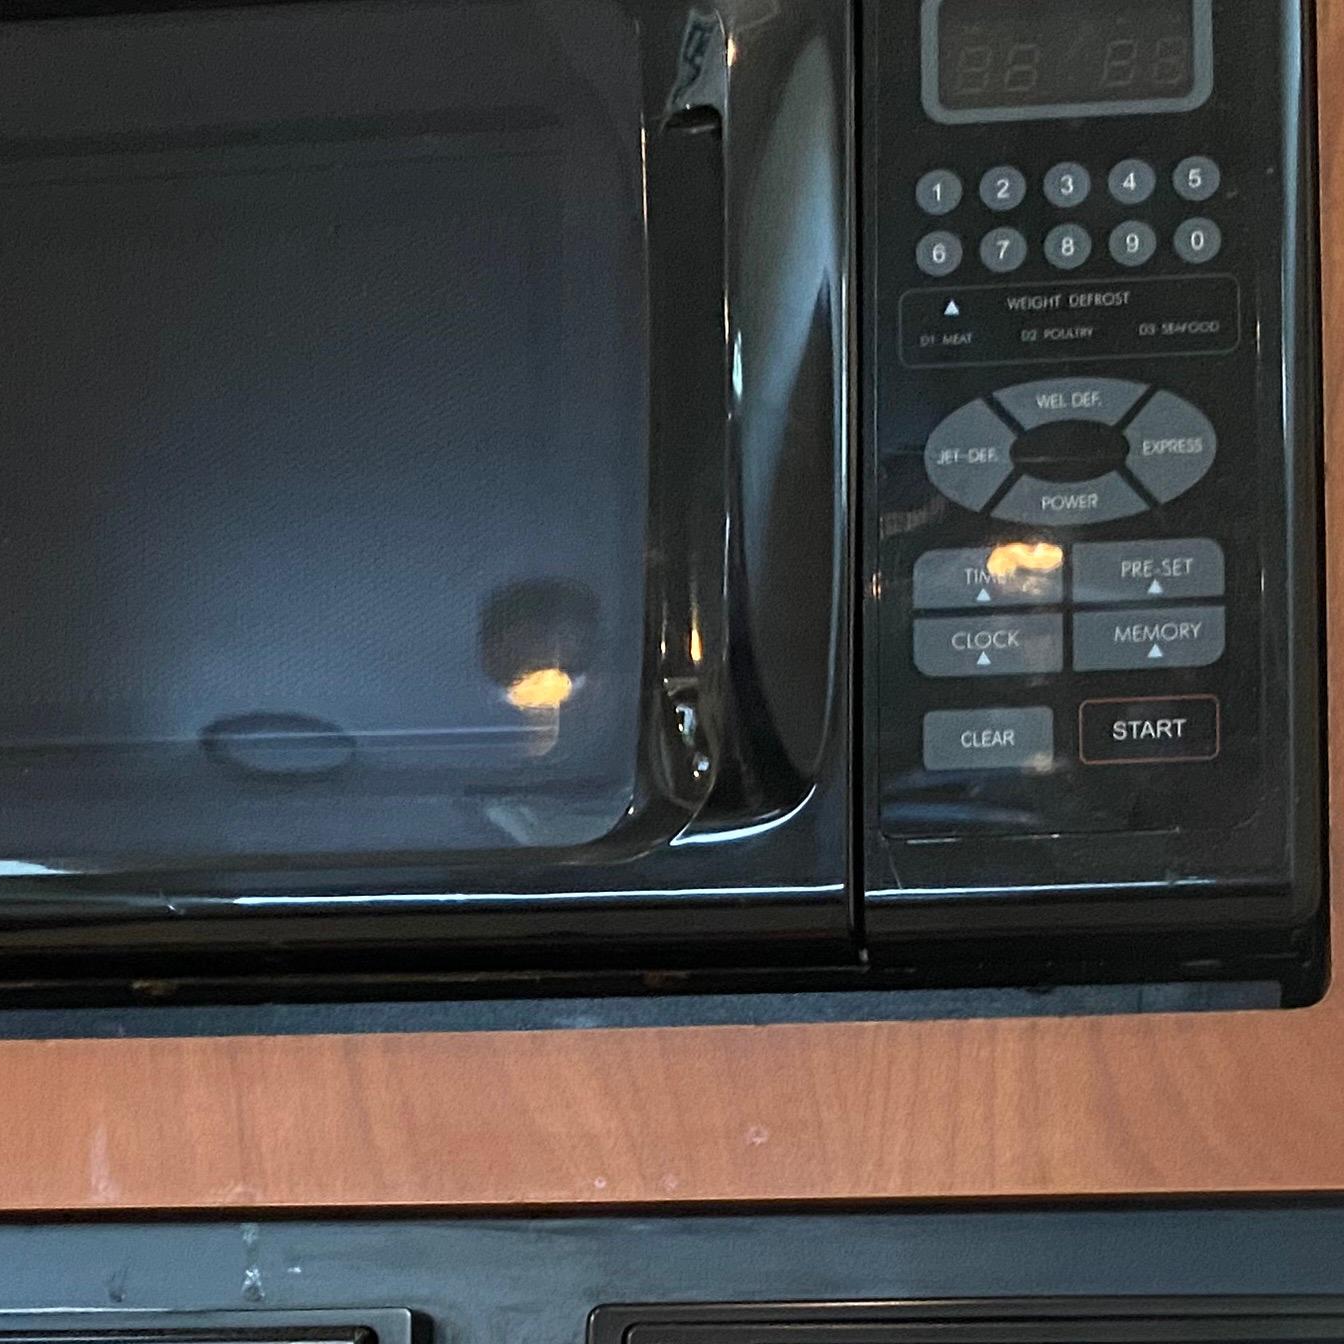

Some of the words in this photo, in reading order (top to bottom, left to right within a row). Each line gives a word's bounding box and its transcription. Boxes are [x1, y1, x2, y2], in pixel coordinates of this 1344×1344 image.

[1007, 296, 1061, 311] WEIGHT
[1069, 291, 1131, 308] DEFROST
[1142, 439, 1203, 455] EXPRESS
[1041, 494, 1098, 510] POWER
[1121, 558, 1194, 577] PRE-SET
[951, 631, 1020, 649] CLOCK
[1114, 623, 1203, 642] MEMORY
[960, 730, 1015, 747] CLEAR
[1112, 719, 1187, 740] START
